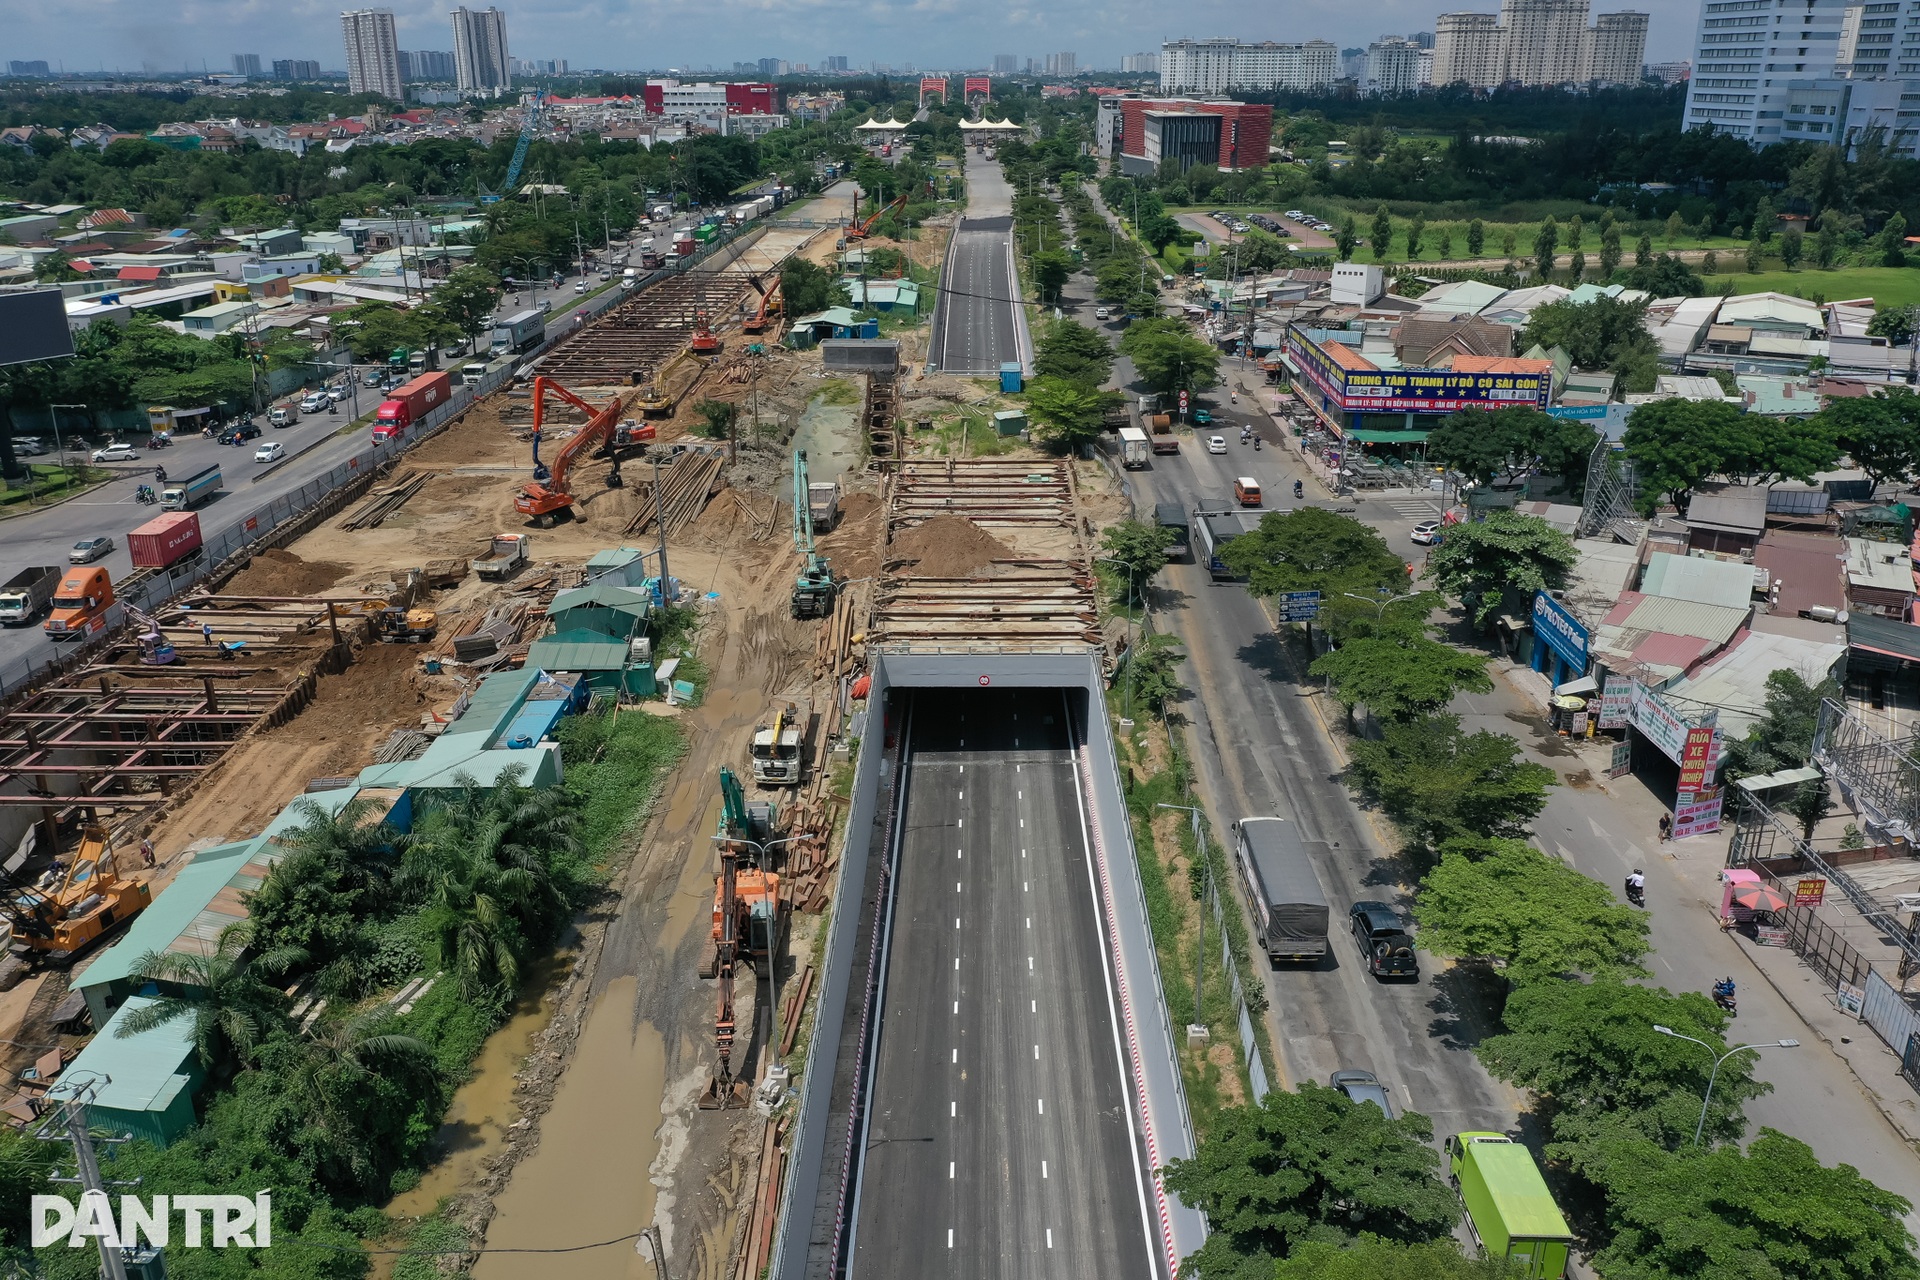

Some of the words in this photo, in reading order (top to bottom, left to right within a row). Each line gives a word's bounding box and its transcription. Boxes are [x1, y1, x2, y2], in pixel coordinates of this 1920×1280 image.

[523, 319, 539, 333] MAERSK
[1348, 375, 1382, 385] TRUNG
[1385, 375, 1406, 386] TÂM
[1410, 377, 1444, 387] THANH
[1446, 376, 1458, 387] LÝ
[1459, 375, 1474, 387] ĐỒ
[1478, 377, 1493, 388] CŨ
[1495, 378, 1513, 388] SÀI
[1516, 378, 1538, 389] GÒN
[1645, 698, 1661, 715] MINH
[1662, 713, 1679, 731] SANG
[1689, 730, 1709, 744] RỬA
[1690, 746, 1704, 756] XE
[1684, 758, 1705, 769] CHUYÊN
[1681, 771, 1702, 784] NGHIỆP
